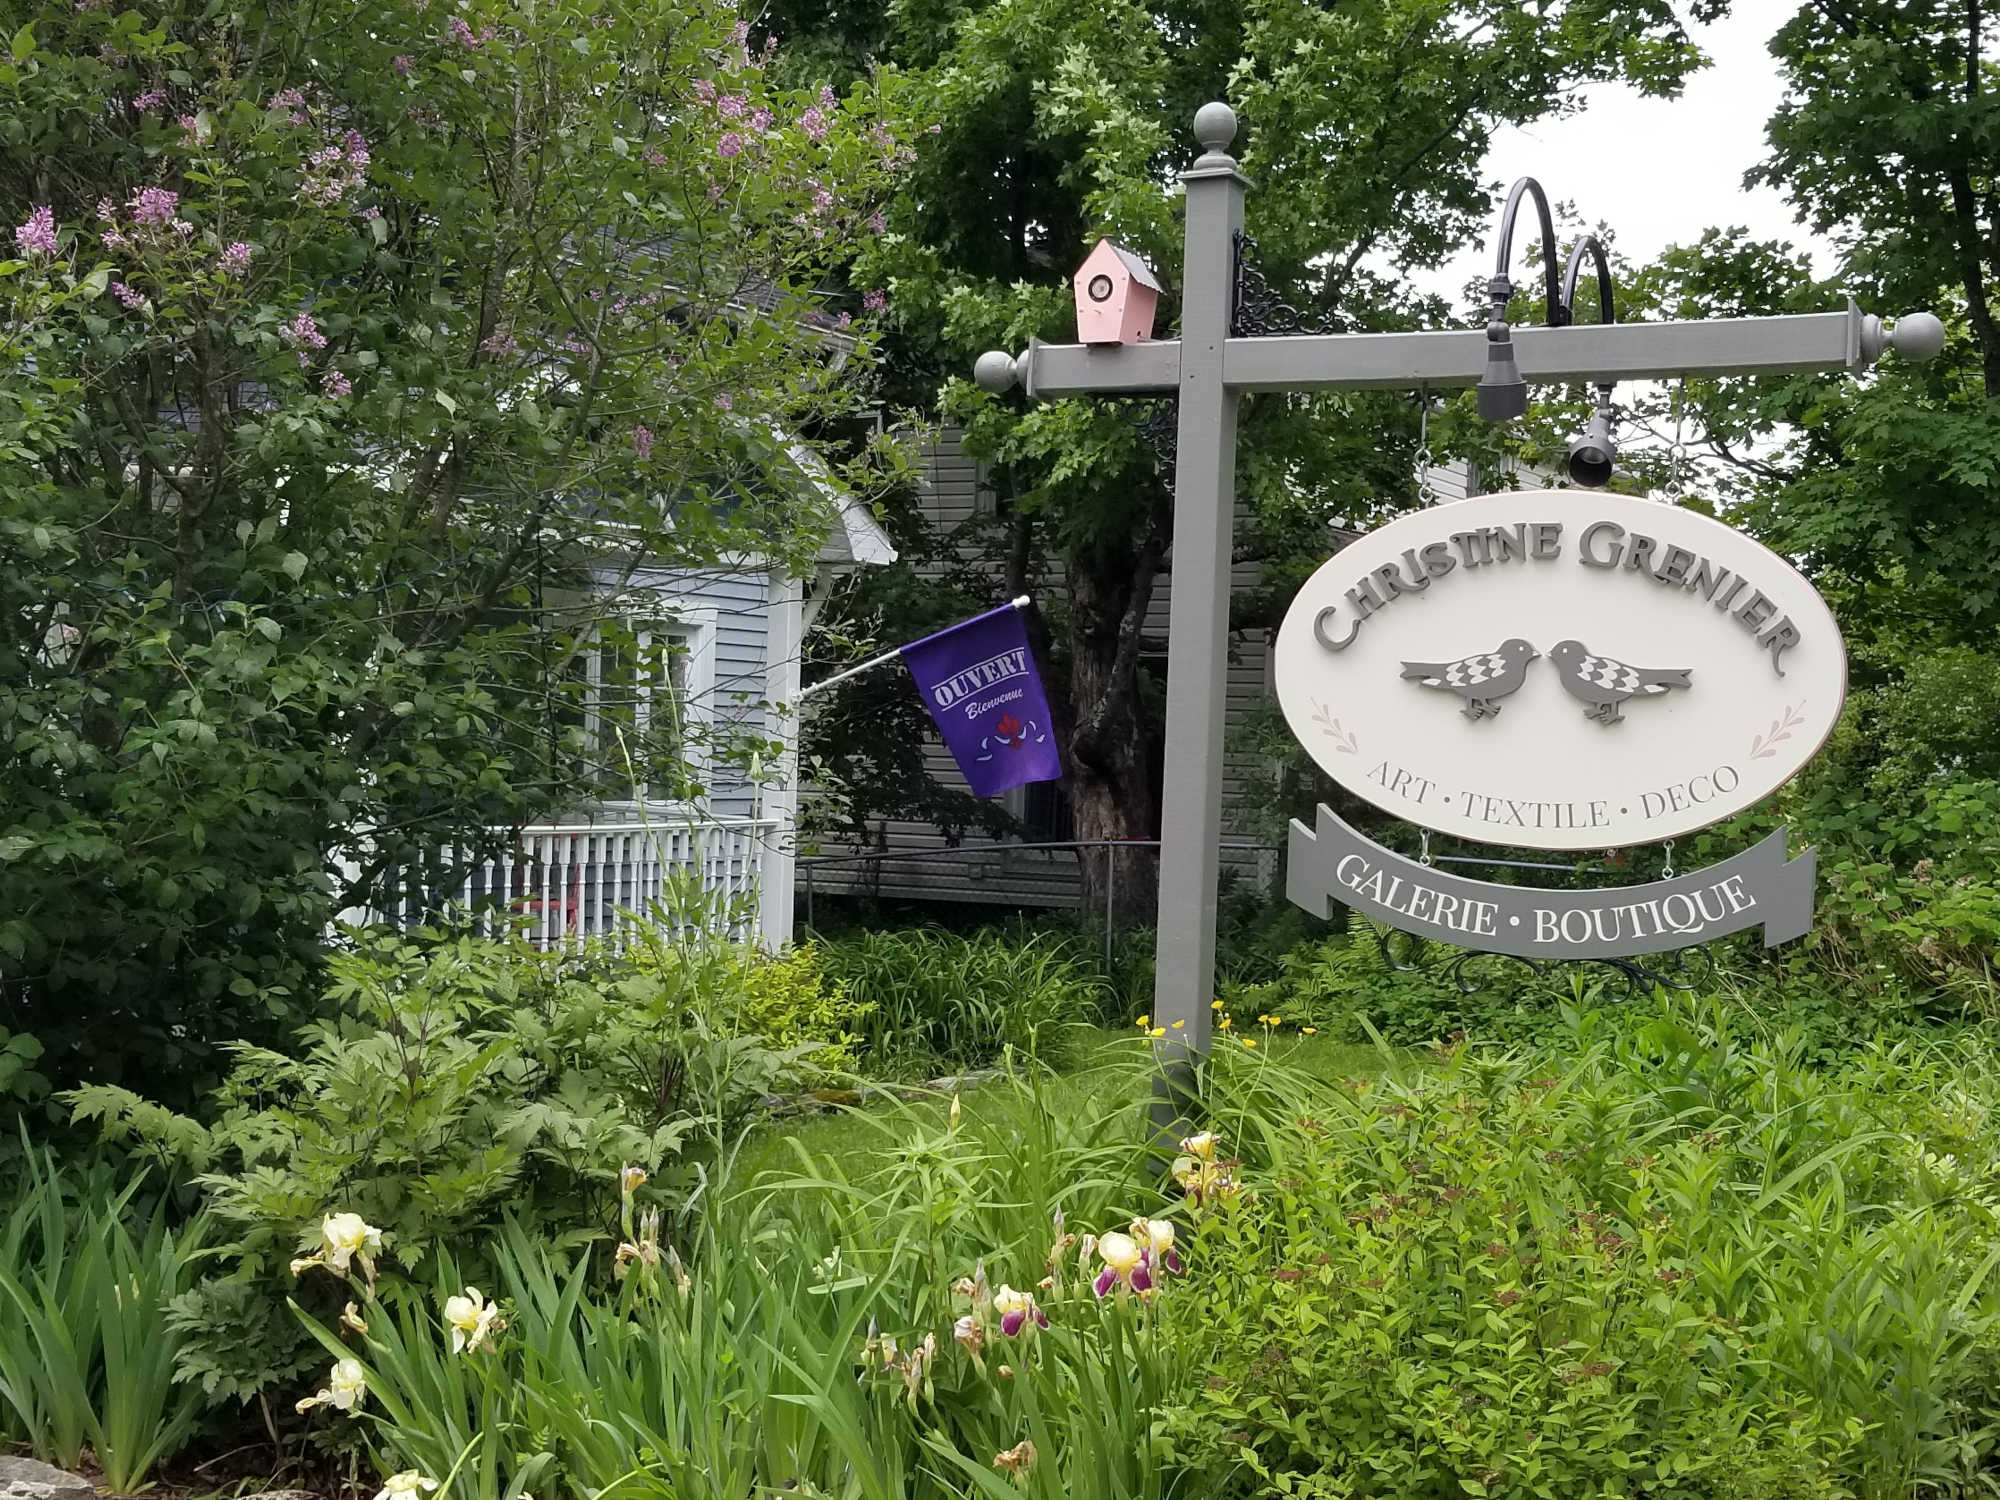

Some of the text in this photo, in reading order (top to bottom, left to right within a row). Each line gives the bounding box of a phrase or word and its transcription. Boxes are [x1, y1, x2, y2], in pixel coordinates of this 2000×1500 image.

[1313, 520, 1802, 677] CHRISTINE GRENIER
[934, 650, 1027, 707] OUVERT
[965, 688, 1024, 720] Bienvenue
[1366, 761, 1740, 829] ART TEXTILE DECO
[1336, 854, 1756, 944] GALERIE BOUTIQUE
